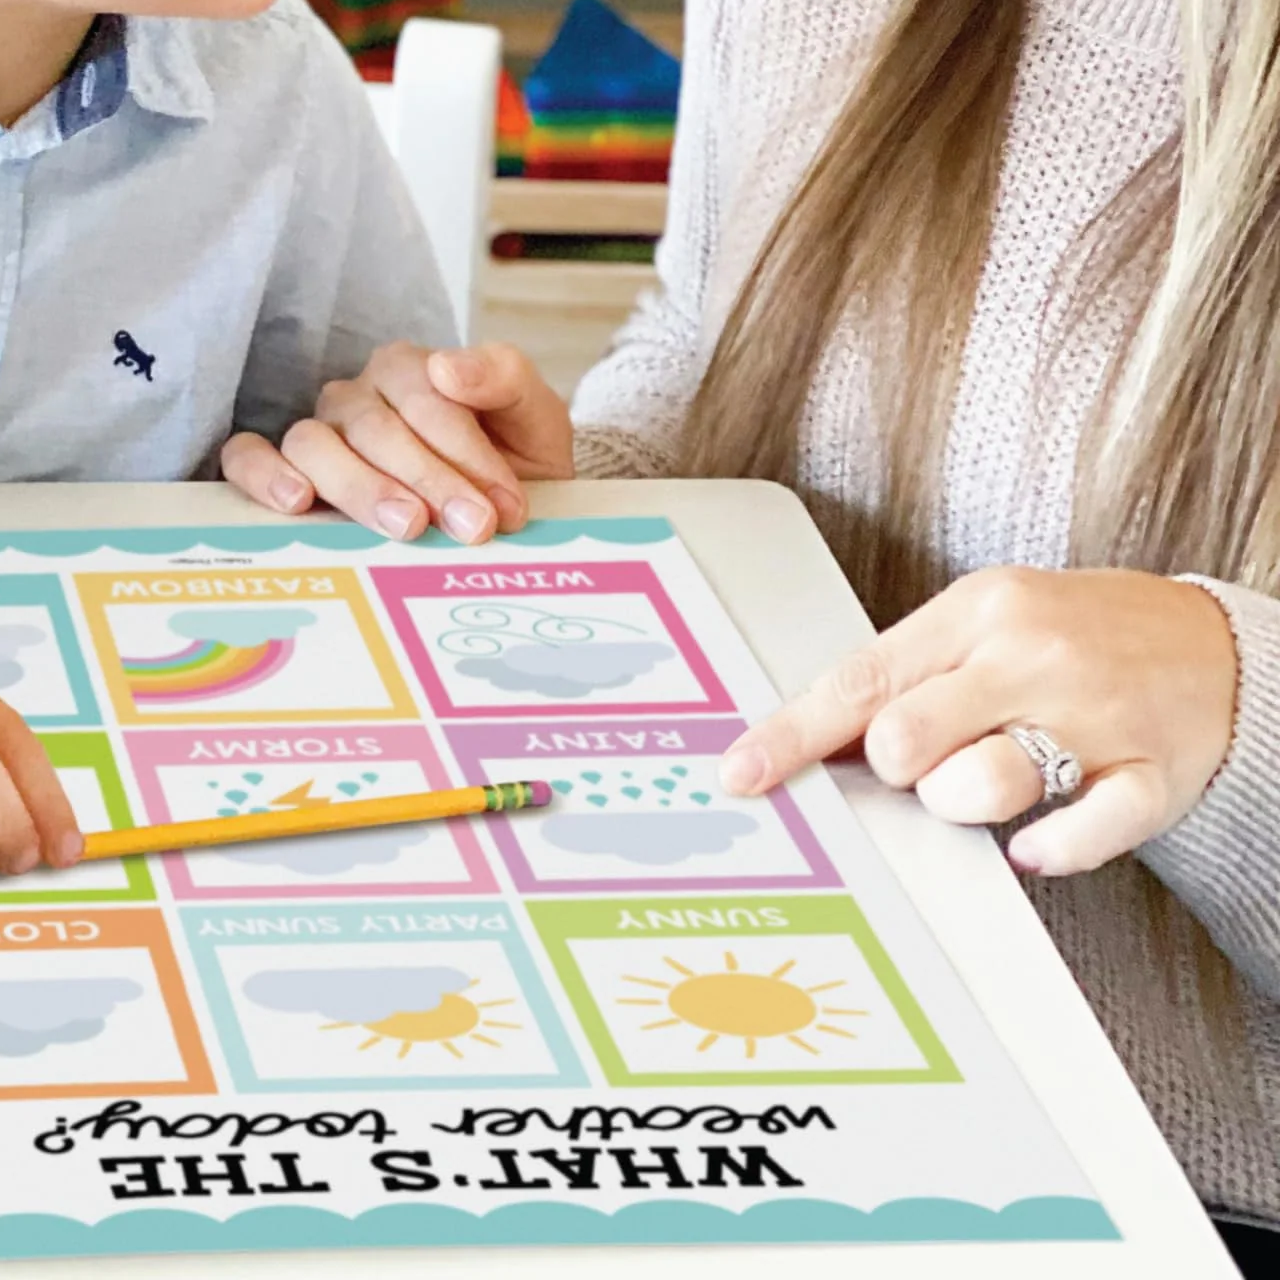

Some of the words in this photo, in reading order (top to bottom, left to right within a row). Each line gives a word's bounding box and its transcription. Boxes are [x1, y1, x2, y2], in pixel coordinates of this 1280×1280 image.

[110, 576, 336, 598] RAINBOW
[442, 570, 596, 590] WINDY
[188, 737, 384, 759] STORMY
[525, 730, 686, 752] RAINY
[199, 915, 341, 936] SUNNY
[360, 912, 510, 934] PARTLY
[617, 906, 790, 930] SUNNY
[33, 1099, 397, 1154] today?
[432, 1105, 837, 1140] weather
[99, 1152, 330, 1200] THE
[370, 1145, 805, 1192] WHAT'S
